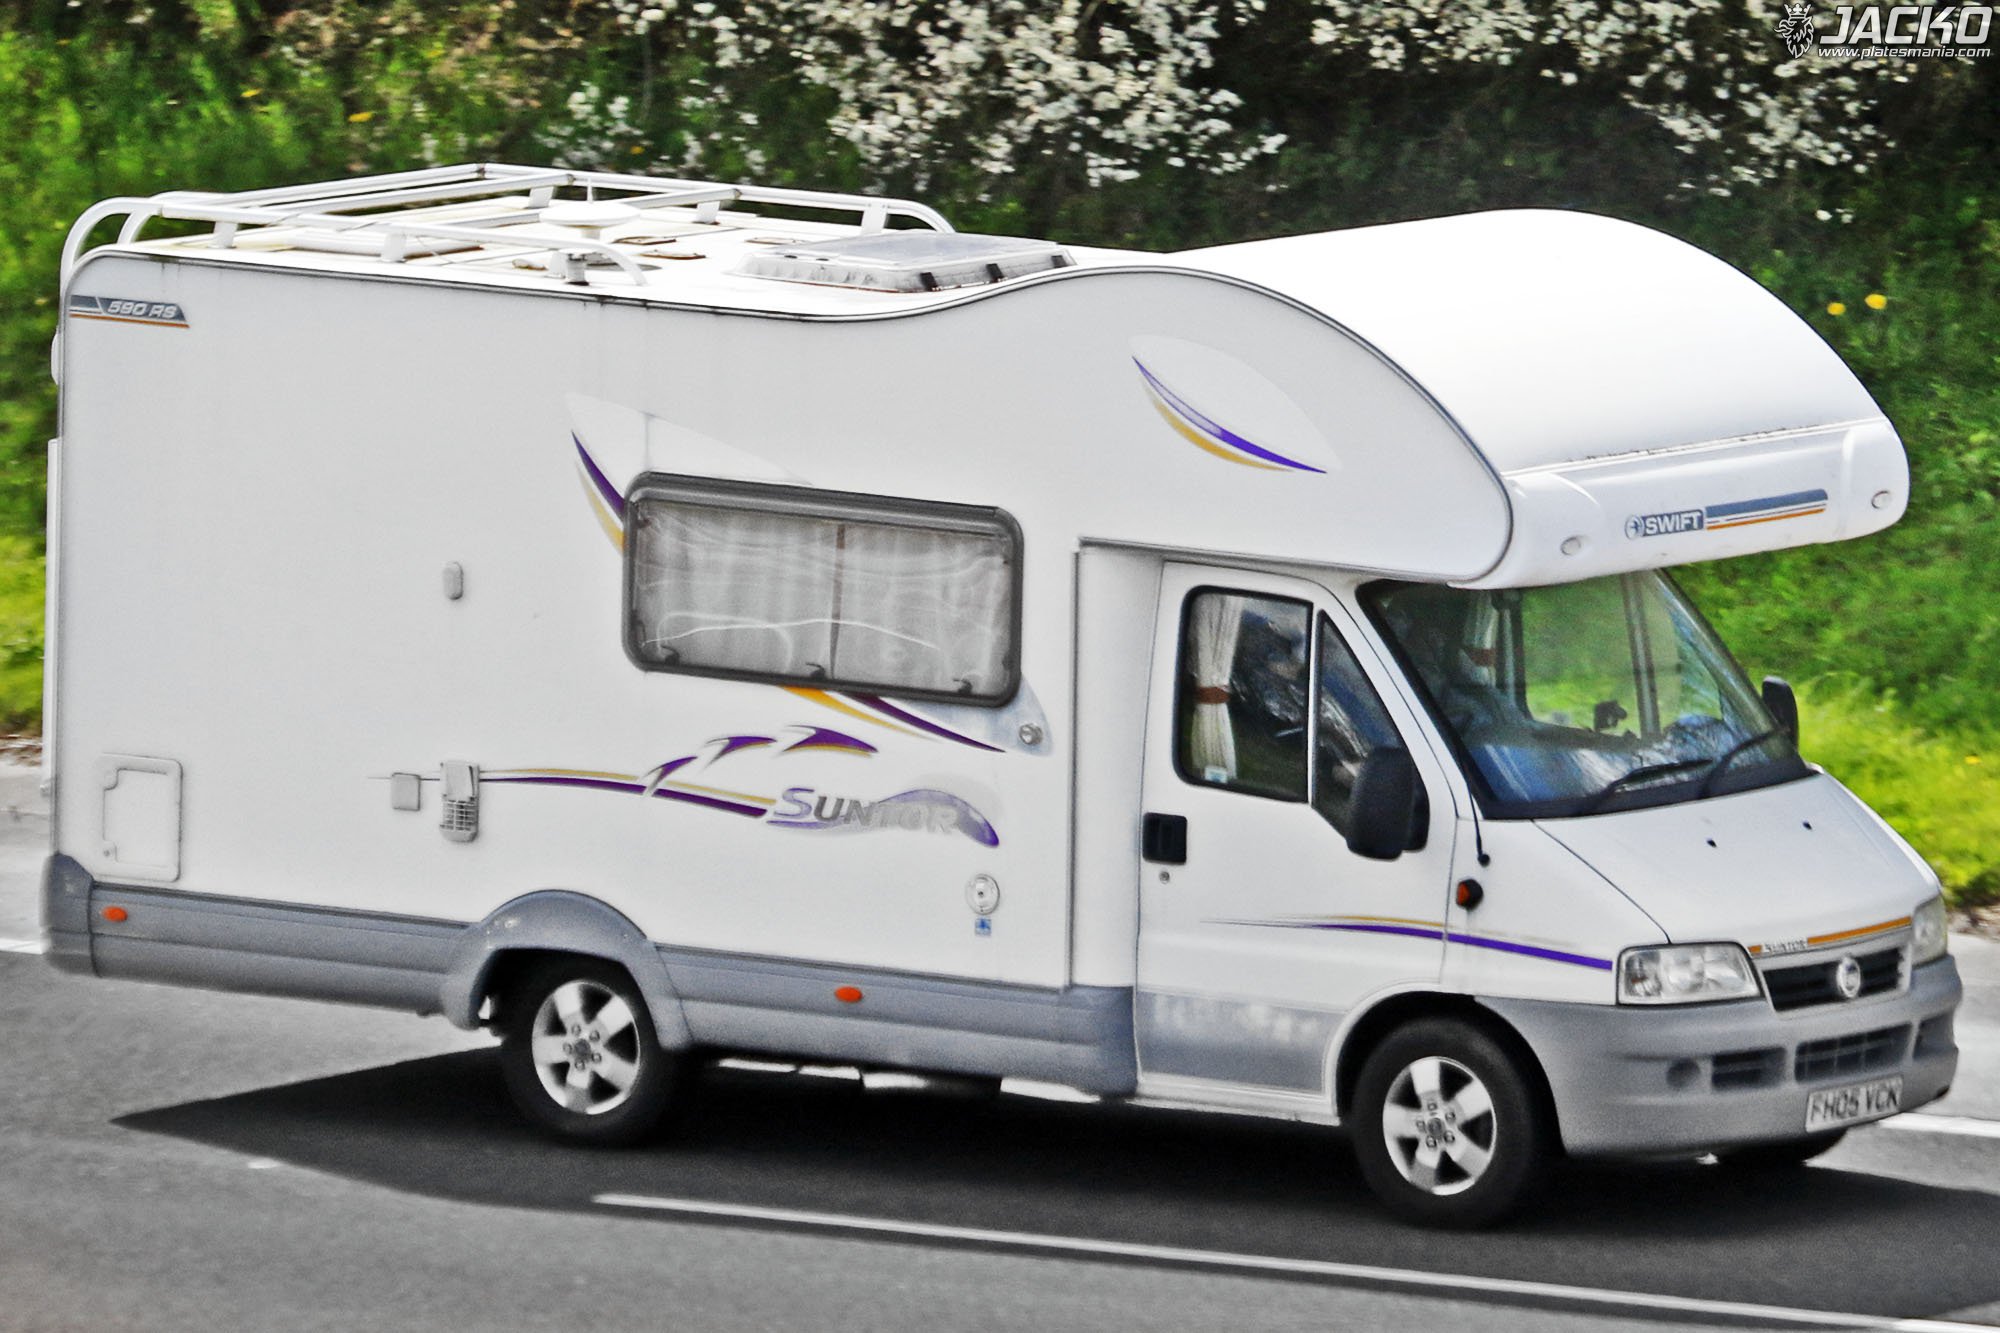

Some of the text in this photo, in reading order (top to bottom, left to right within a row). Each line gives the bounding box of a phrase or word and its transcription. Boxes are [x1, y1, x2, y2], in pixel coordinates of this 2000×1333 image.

[107, 301, 177, 318] 590 RS
[1645, 511, 1702, 535] SWIFT
